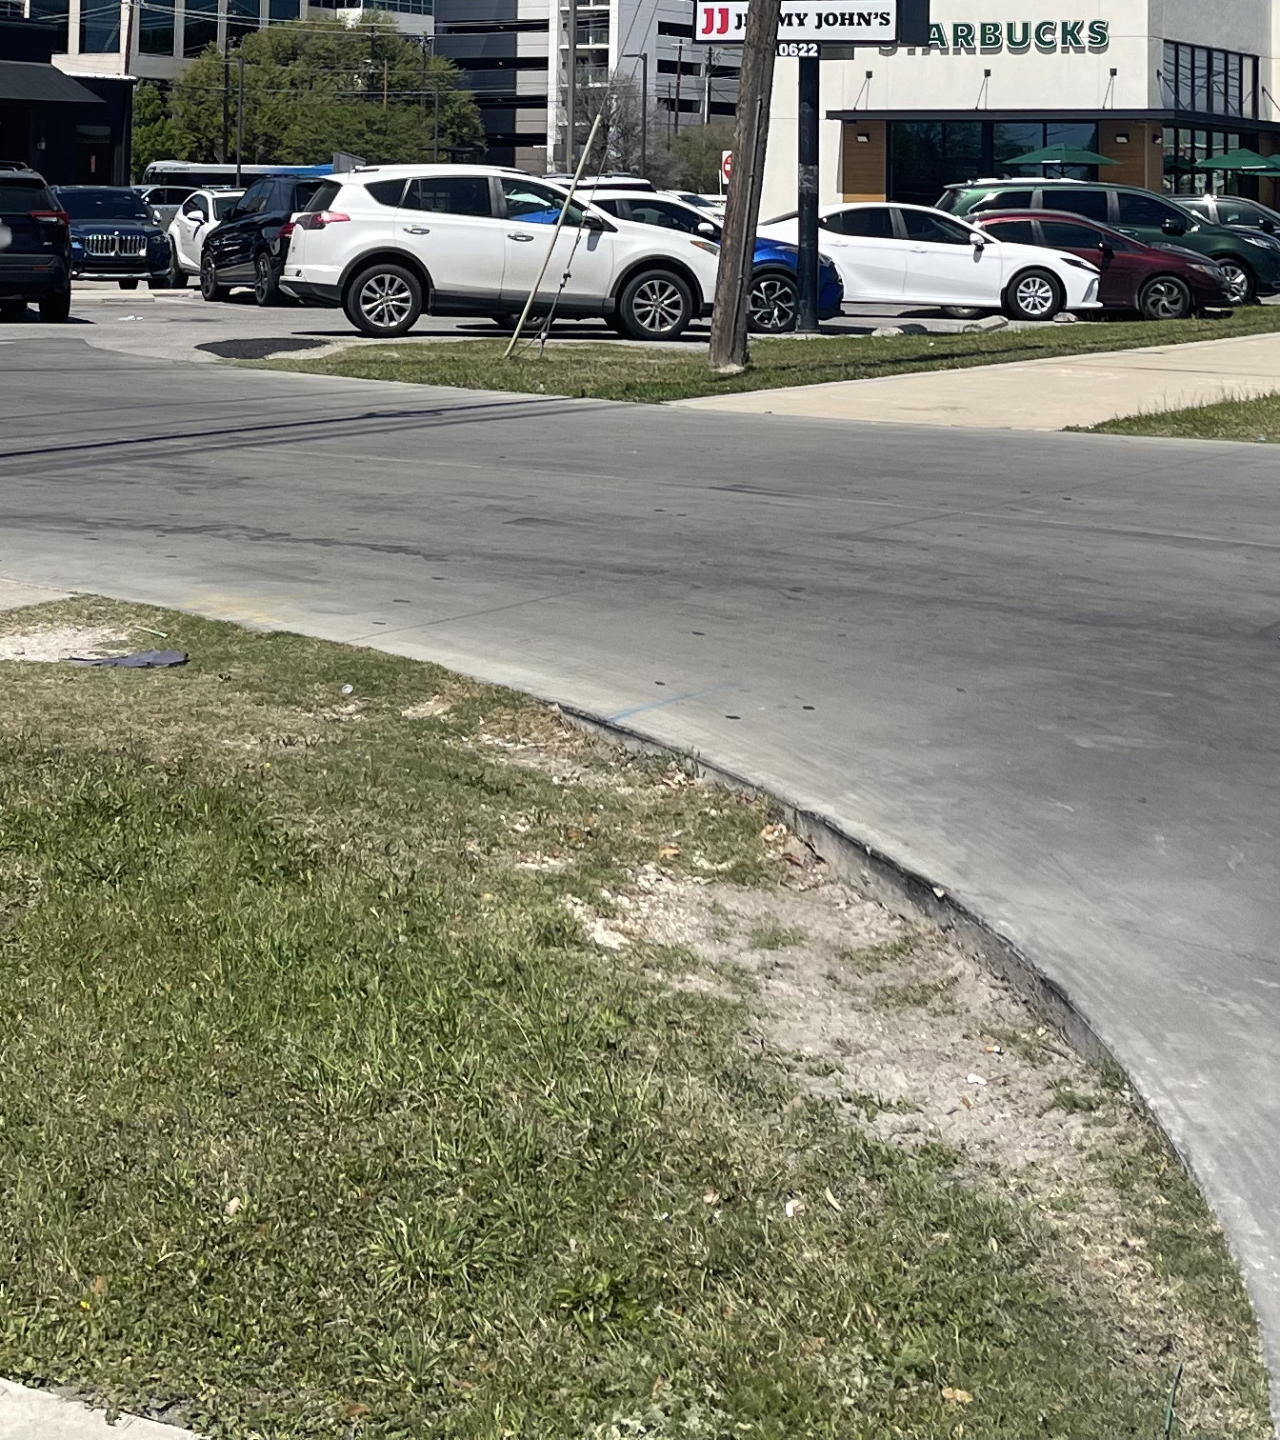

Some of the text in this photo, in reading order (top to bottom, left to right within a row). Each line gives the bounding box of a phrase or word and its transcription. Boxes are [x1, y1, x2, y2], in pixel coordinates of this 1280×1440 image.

[701, 7, 730, 35] JJ
[814, 11, 891, 30] JOHN'S
[883, 20, 1110, 51] ARBUCKS
